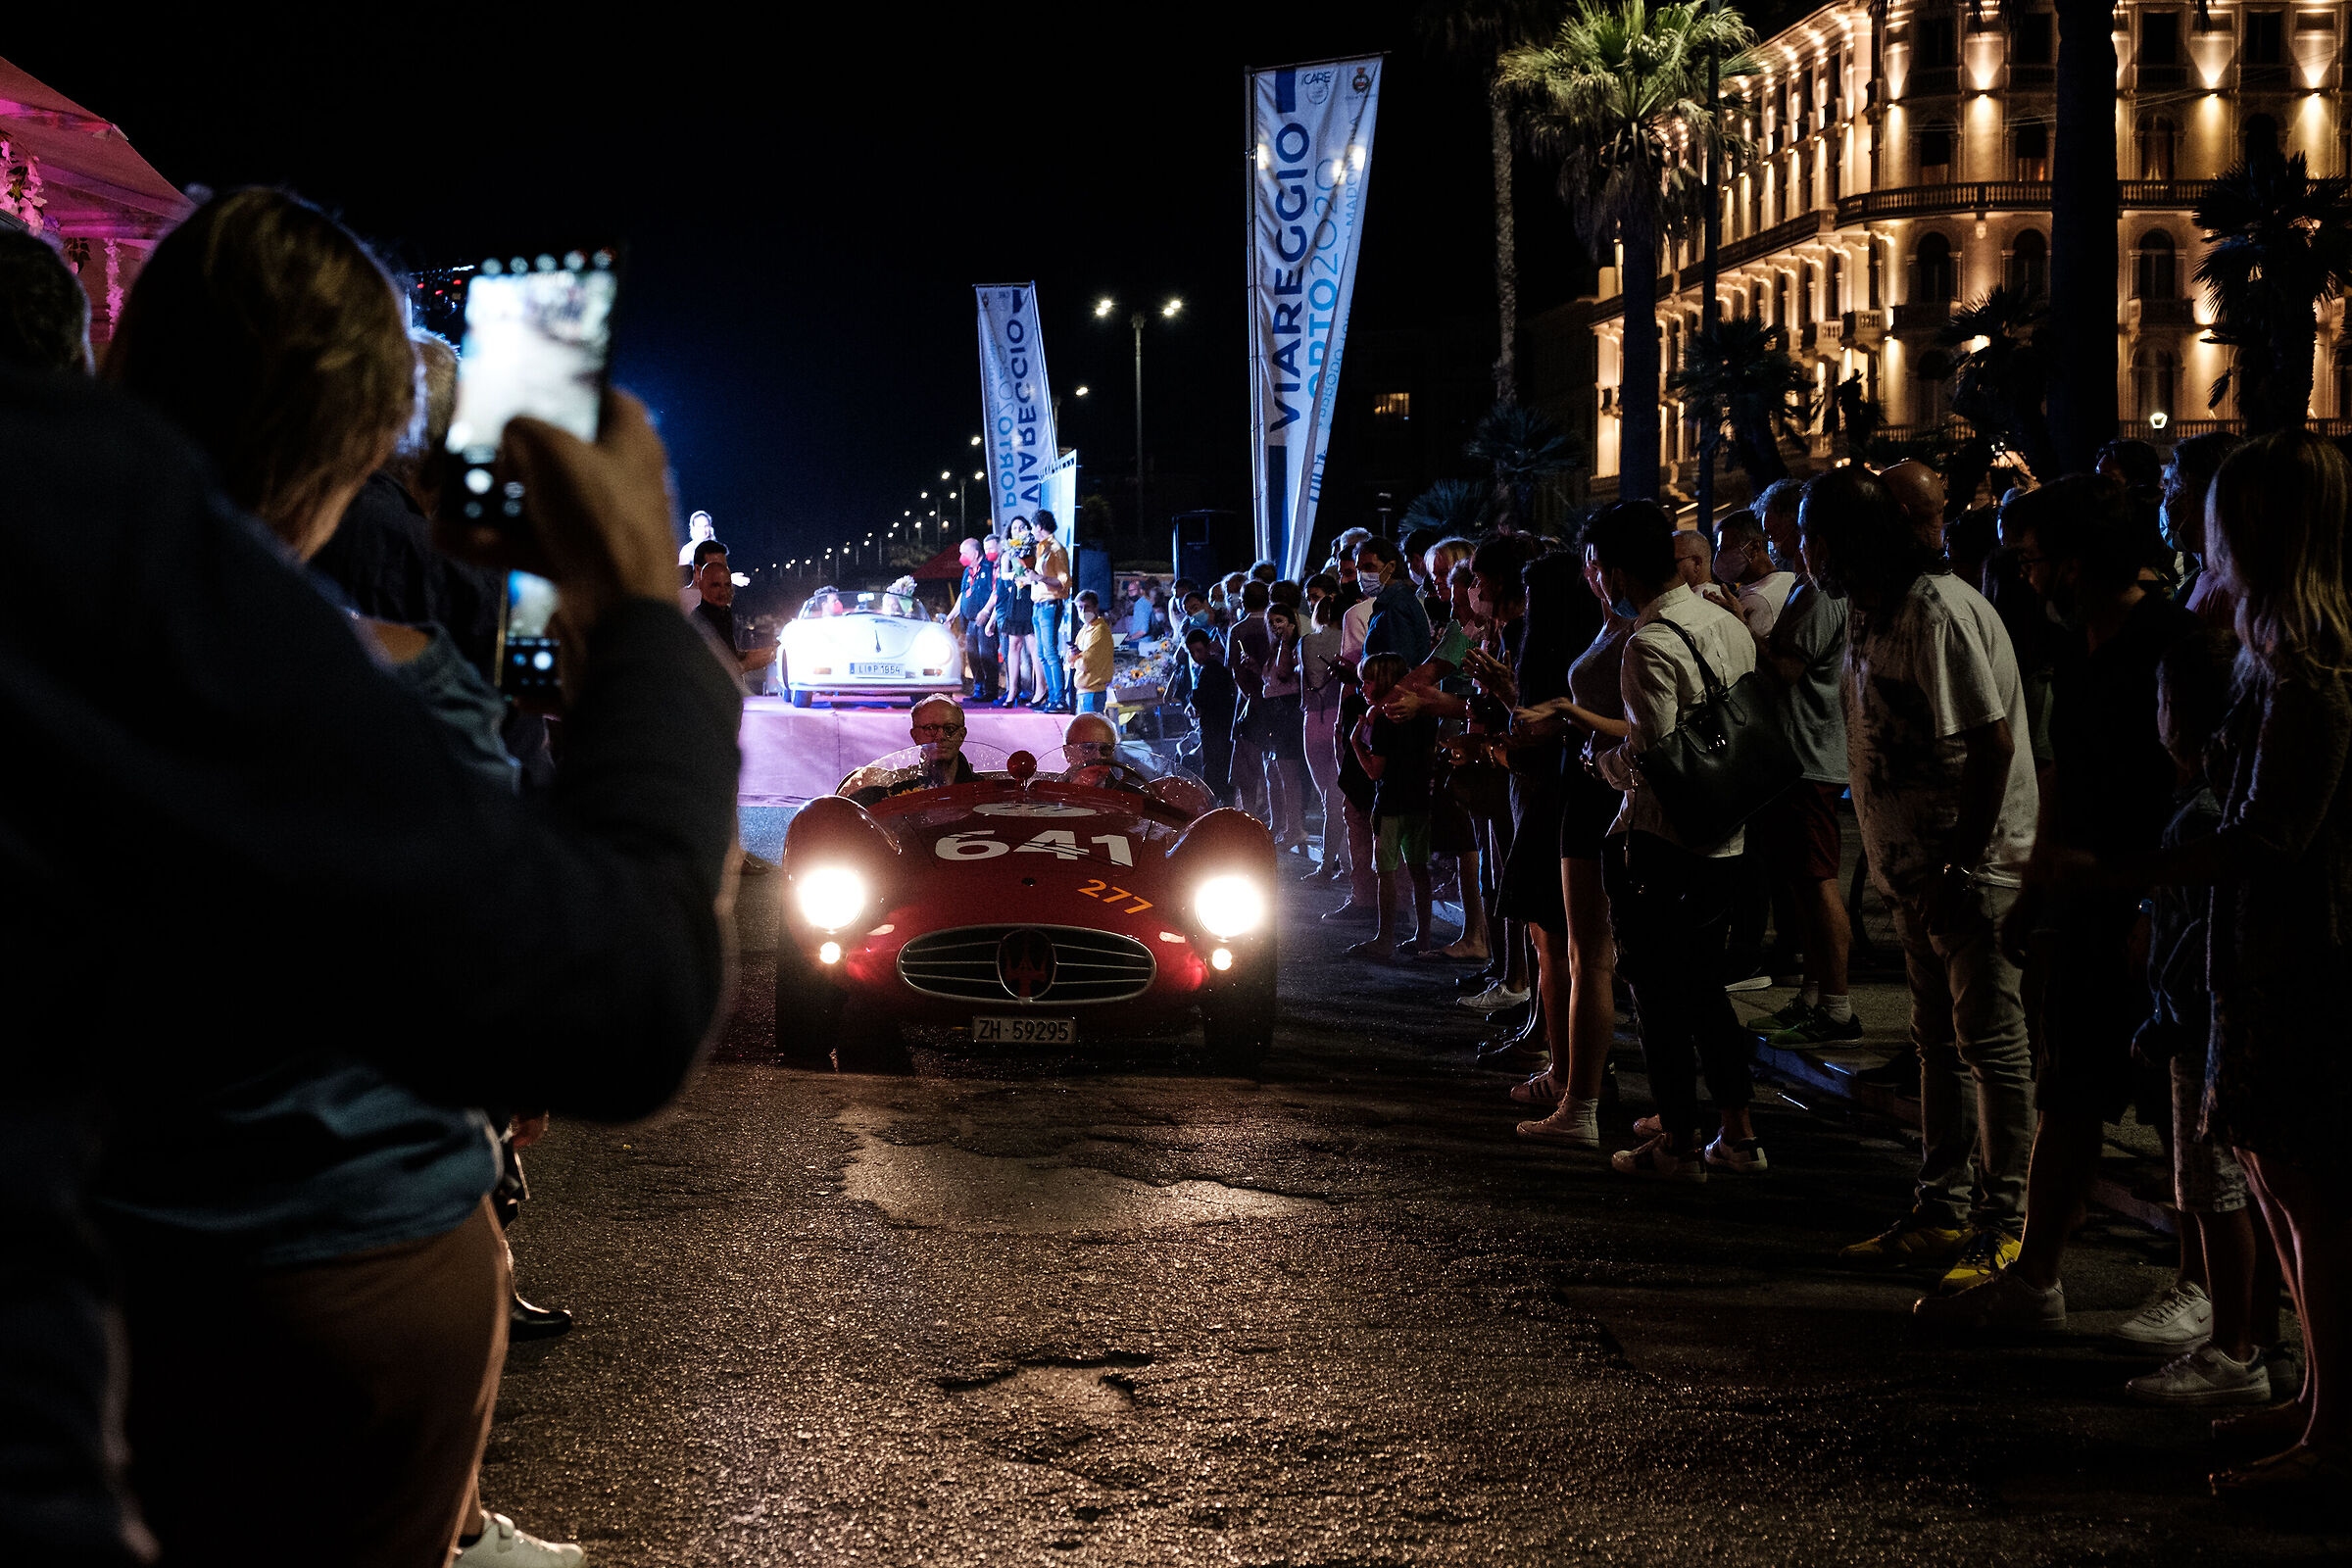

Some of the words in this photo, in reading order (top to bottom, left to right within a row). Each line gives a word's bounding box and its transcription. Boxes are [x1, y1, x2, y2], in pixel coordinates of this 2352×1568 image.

[1270, 122, 1310, 433] VIAREGGIO
[934, 829, 1133, 867] 641
[1077, 879, 1153, 914] 277
